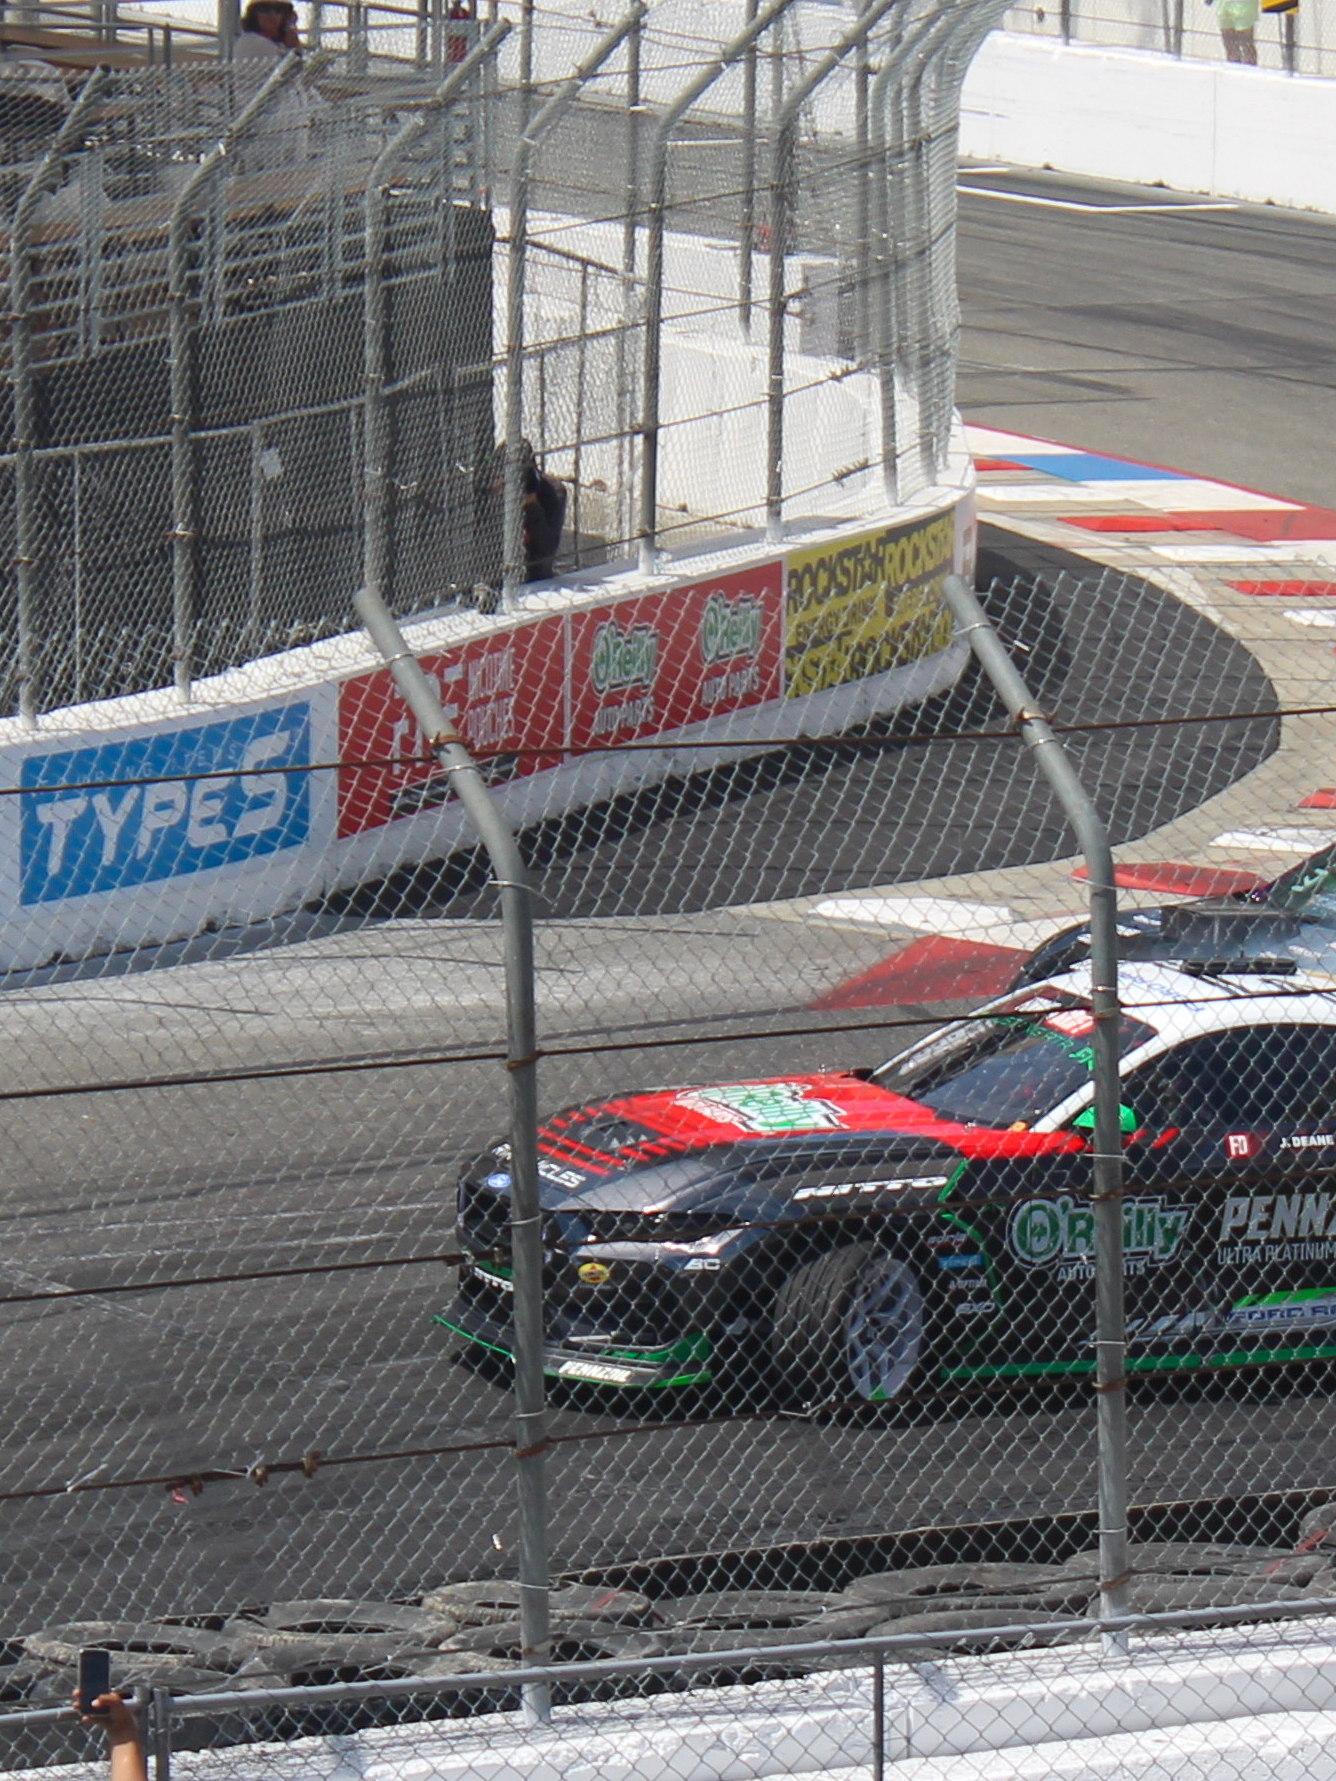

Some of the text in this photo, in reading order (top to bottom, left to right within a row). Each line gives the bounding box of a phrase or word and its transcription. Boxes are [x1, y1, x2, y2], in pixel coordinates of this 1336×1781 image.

[1279, 1137, 1291, 1149] J.
[1292, 1134, 1334, 1148] DEANE
[1010, 1195, 1190, 1263] O'Rilly
[1217, 1245, 1262, 1265] ULTRA
